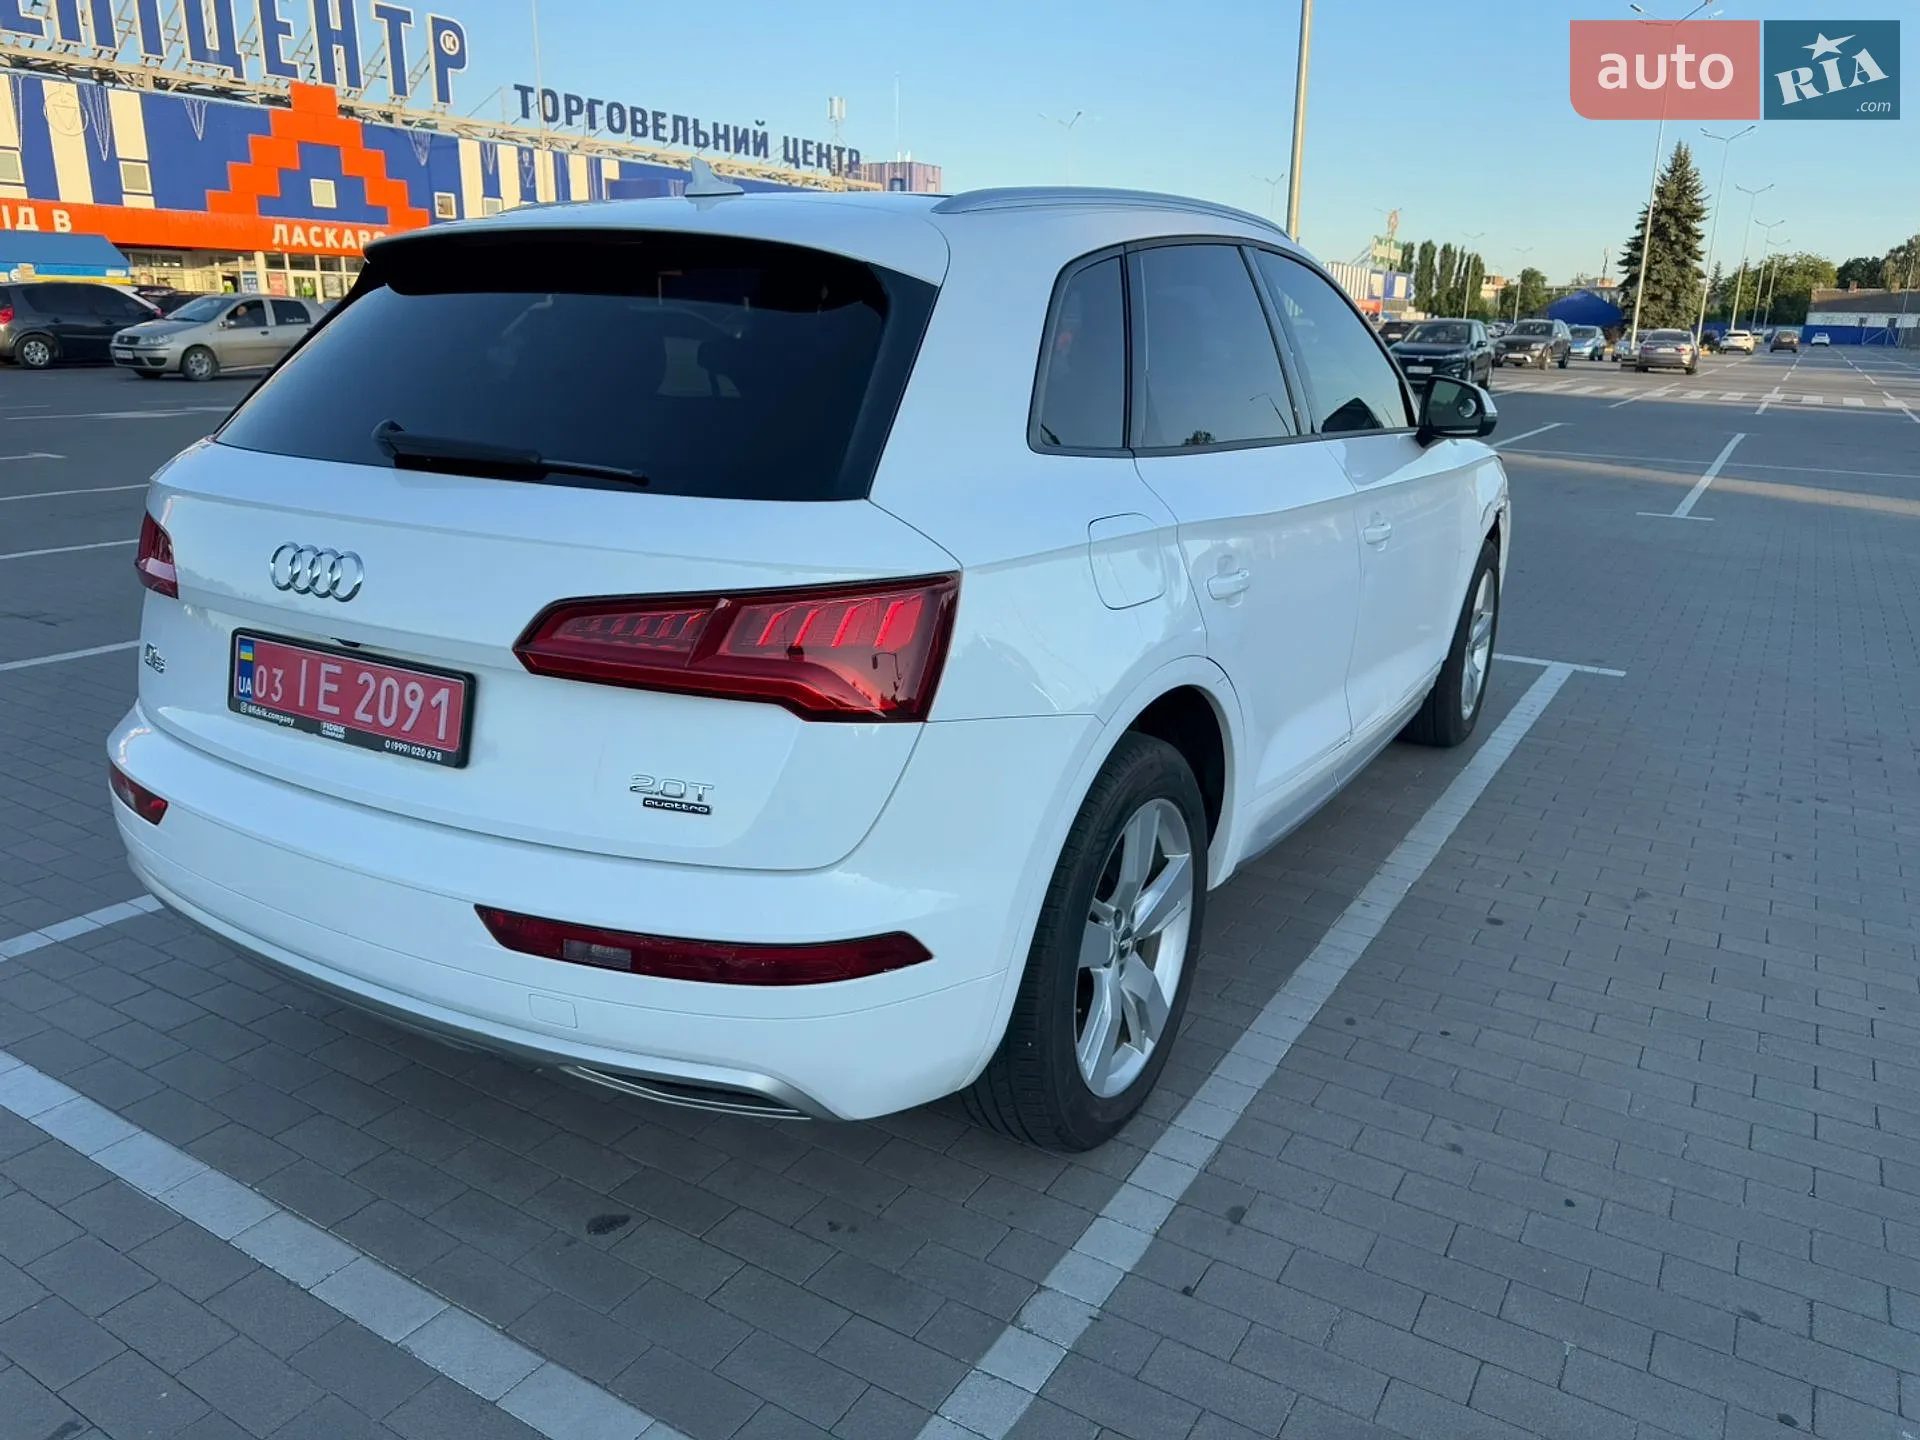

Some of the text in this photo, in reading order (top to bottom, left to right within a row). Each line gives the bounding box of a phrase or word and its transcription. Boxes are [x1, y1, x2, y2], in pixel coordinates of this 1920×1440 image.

[513, 83, 861, 175] ТОРГОВЕЛЬНИЙ ЦЕНТР
[52, 208, 72, 233] В
[238, 676, 252, 696] UA
[254, 658, 450, 741] 03 IE 2091
[629, 774, 715, 802] 2.0T
[644, 798, 709, 814] quattro
